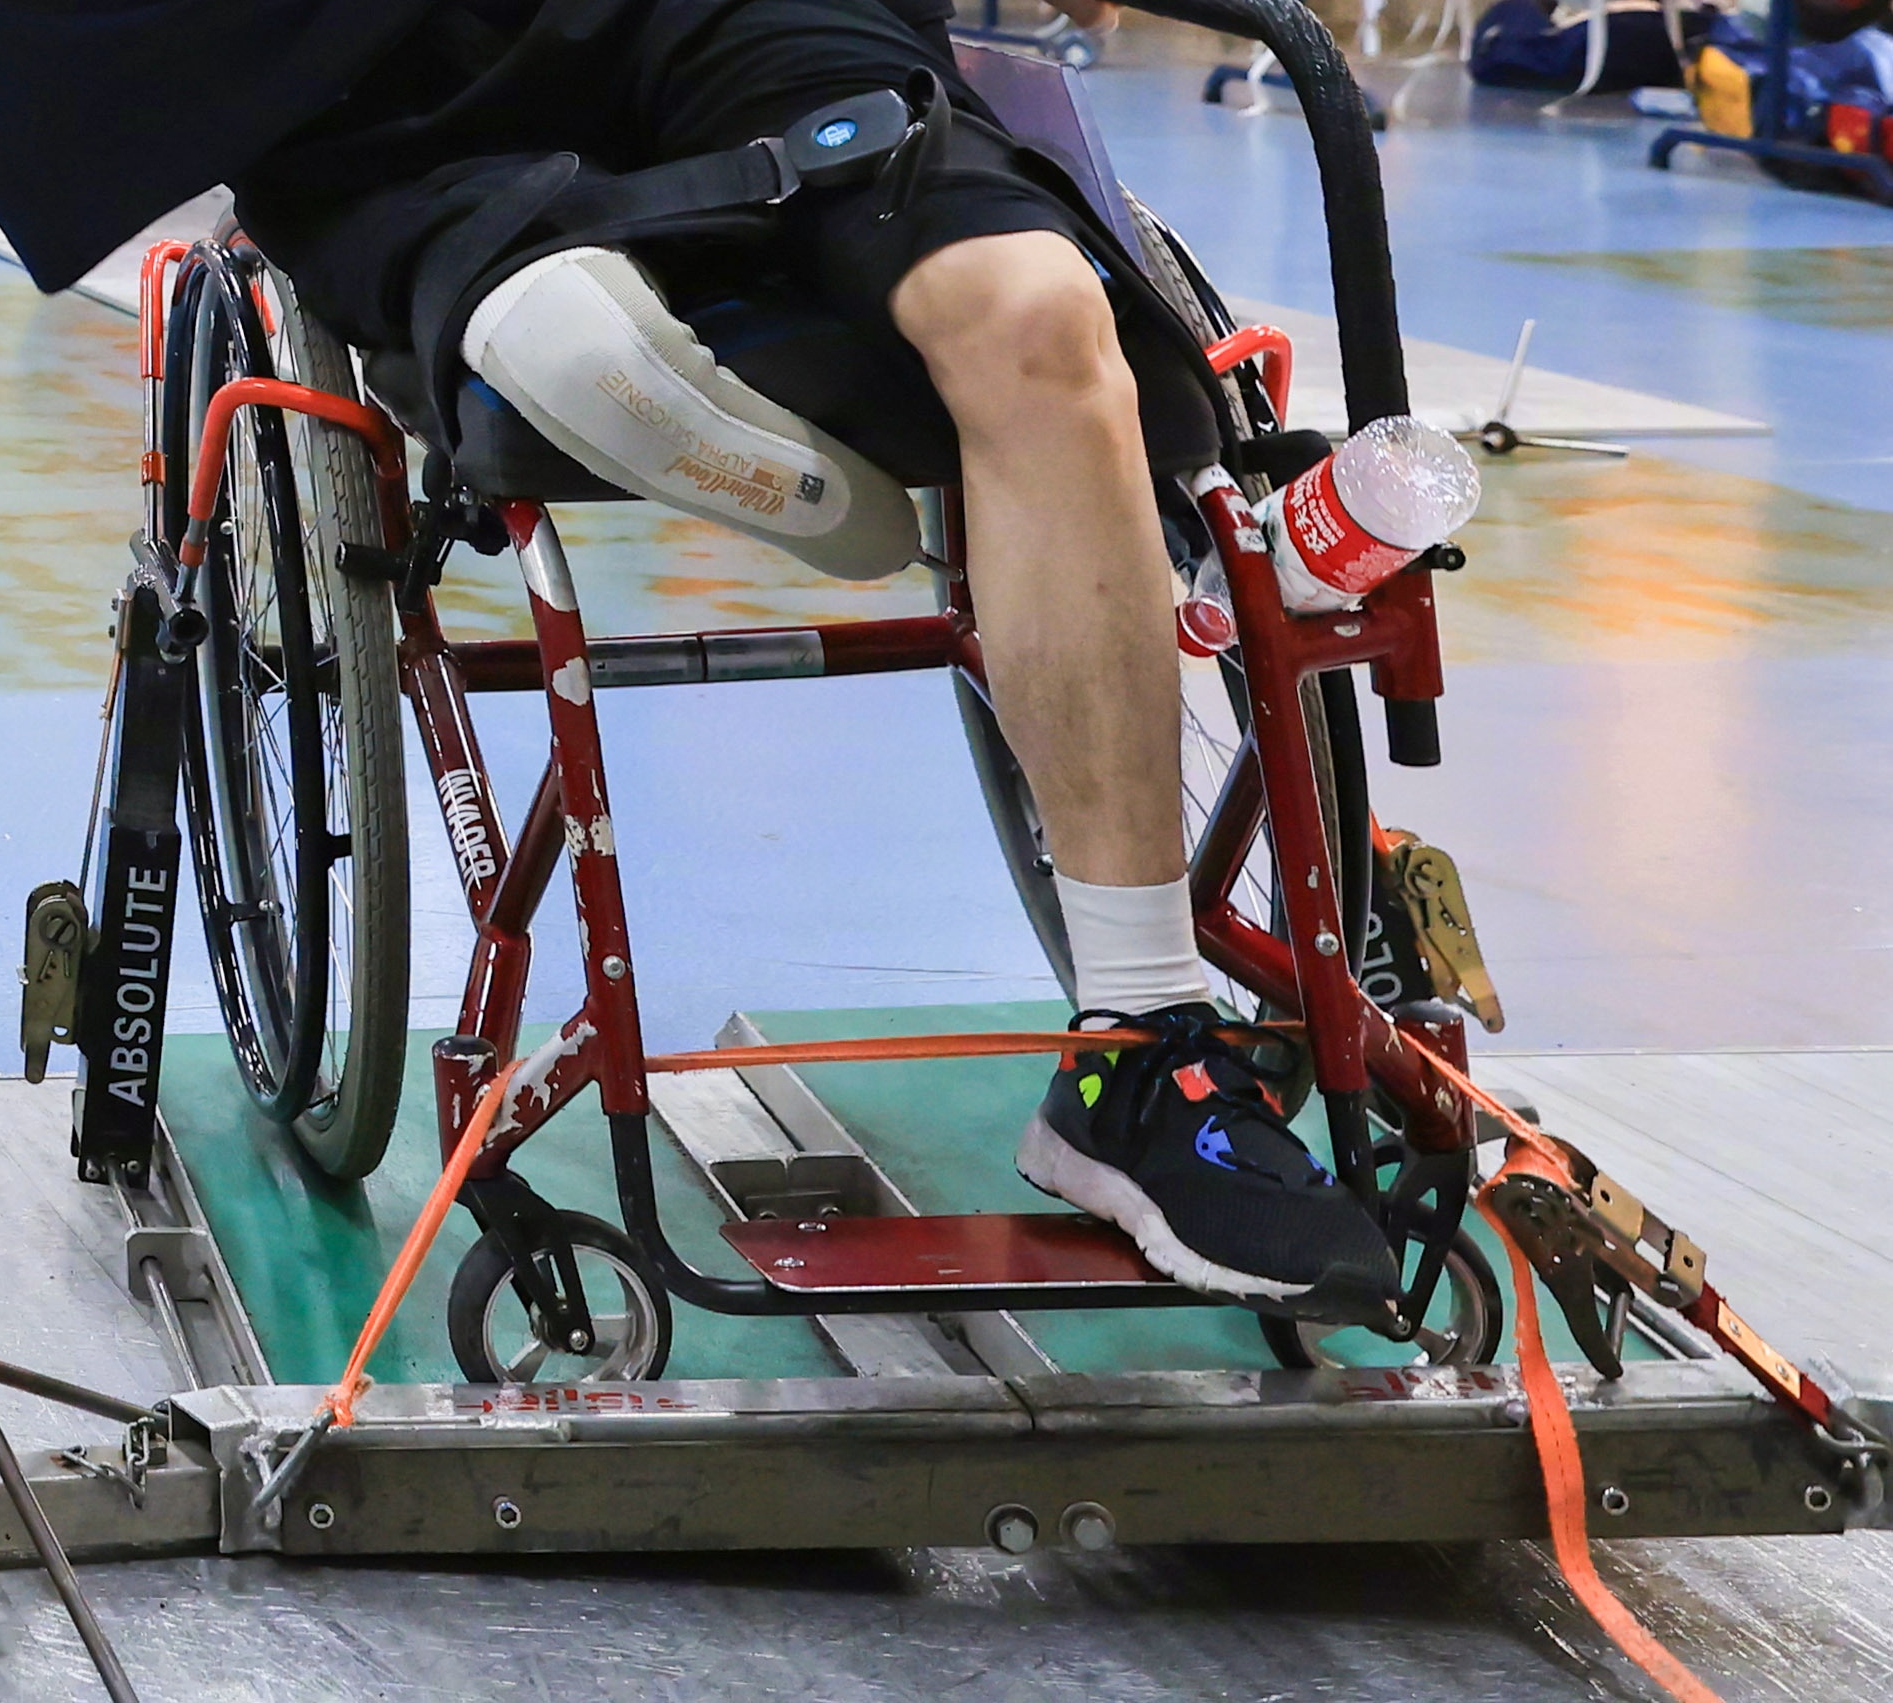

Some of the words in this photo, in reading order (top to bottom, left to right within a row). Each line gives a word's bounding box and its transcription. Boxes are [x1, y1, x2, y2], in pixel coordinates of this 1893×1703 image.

[698, 439, 753, 472] ALPHA
[437, 768, 497, 896] INVADER
[108, 866, 167, 1108] ABSOLUTE
